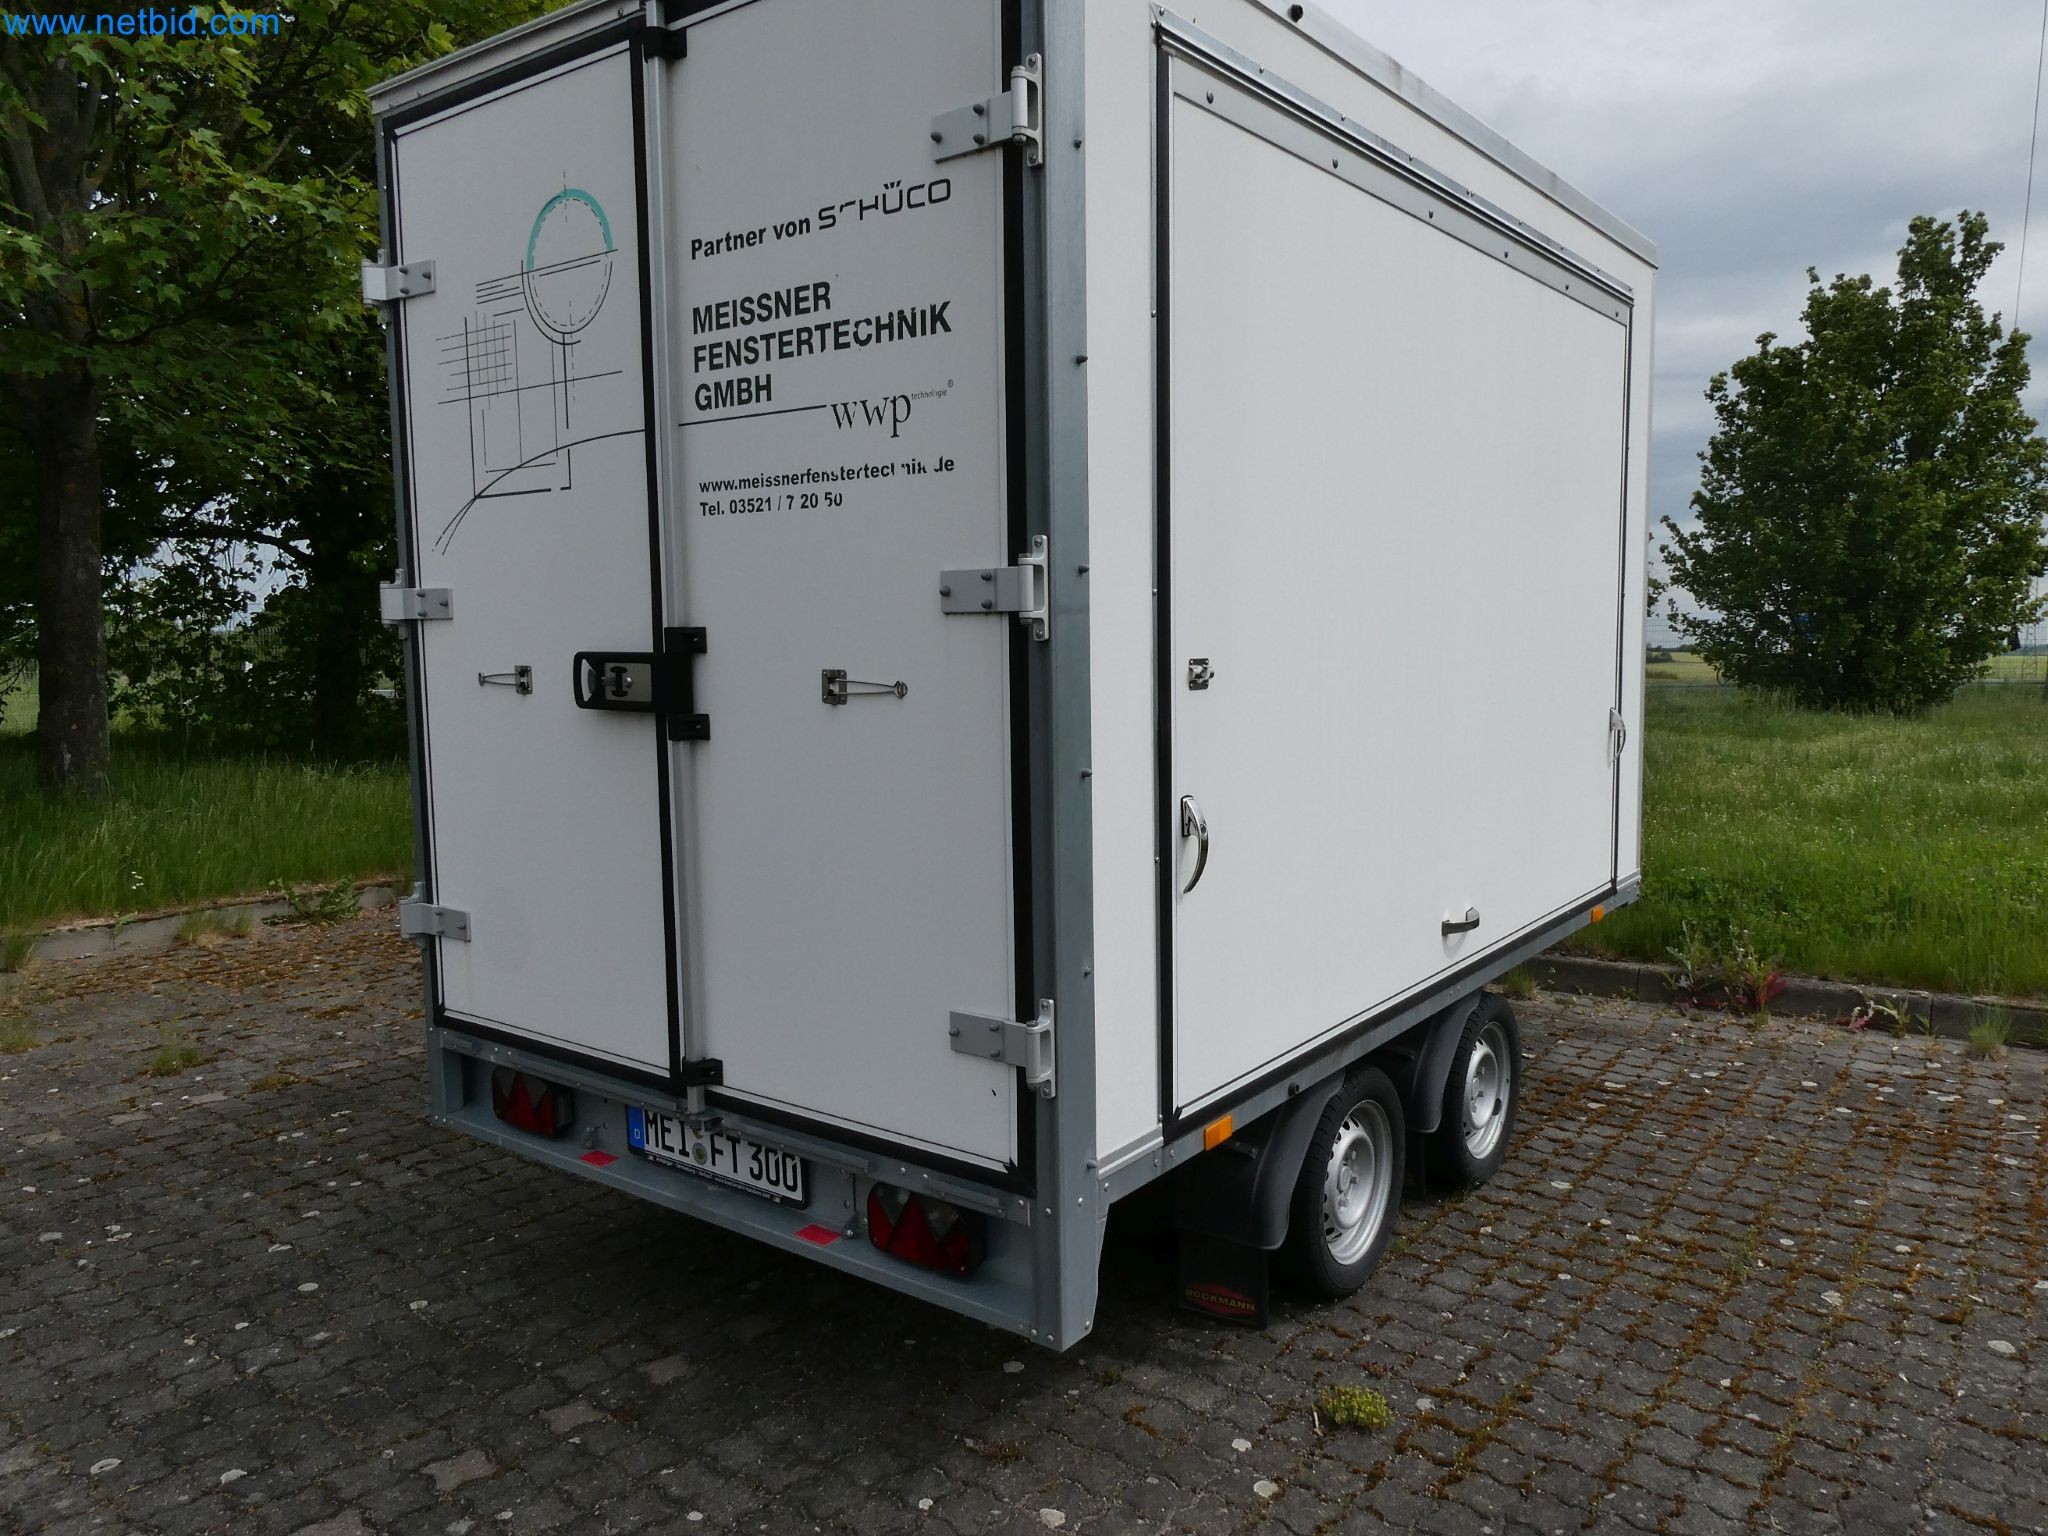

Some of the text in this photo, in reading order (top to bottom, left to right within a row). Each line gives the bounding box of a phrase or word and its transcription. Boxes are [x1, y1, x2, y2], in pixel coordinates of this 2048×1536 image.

[691, 227, 766, 260] Partner
[773, 217, 811, 240] von
[692, 281, 831, 334] MEISSNER
[694, 301, 952, 373] FENSTERTECHNIK
[695, 374, 772, 411] GMBH
[831, 393, 911, 438] wwp
[699, 456, 954, 493] www.meissnerfenstertecnikde
[700, 501, 725, 516] Tel.
[729, 497, 772, 514] 03521
[777, 496, 782, 511] /
[787, 495, 795, 510] 7
[800, 493, 818, 510] 20
[644, 1110, 690, 1157] MEI
